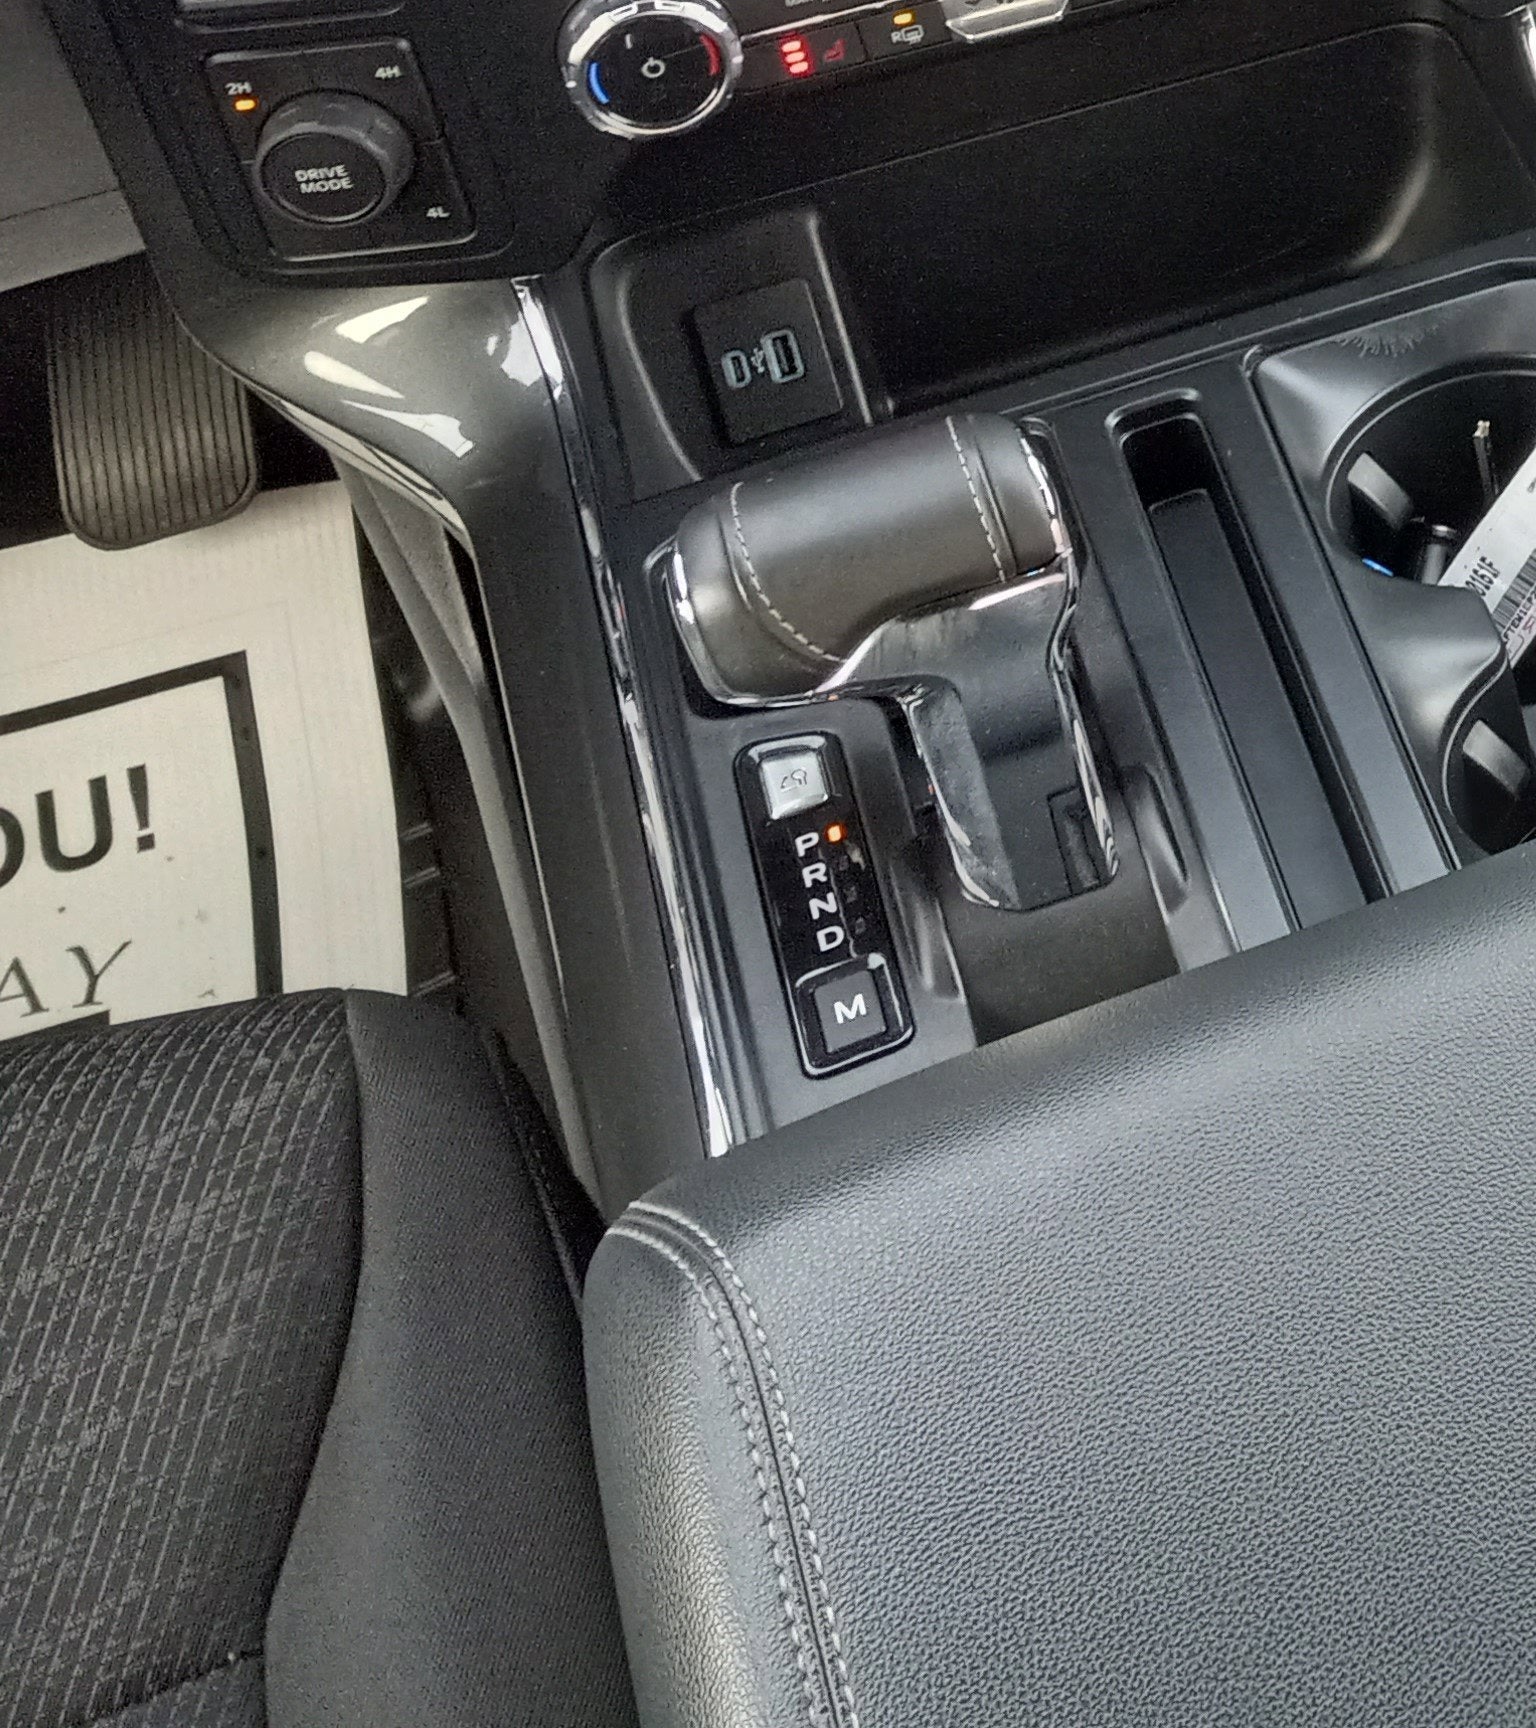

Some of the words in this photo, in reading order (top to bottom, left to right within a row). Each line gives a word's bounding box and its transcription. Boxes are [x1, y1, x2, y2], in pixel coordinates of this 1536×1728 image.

[374, 65, 401, 79] 4H
[225, 82, 252, 95] 2H
[294, 164, 349, 183] DRIVE
[300, 176, 354, 194] MODE
[426, 207, 451, 220] 4L
[795, 832, 819, 857] P
[802, 862, 828, 888] R
[808, 892, 838, 921] N
[816, 925, 846, 953] D
[834, 992, 867, 1024] M
